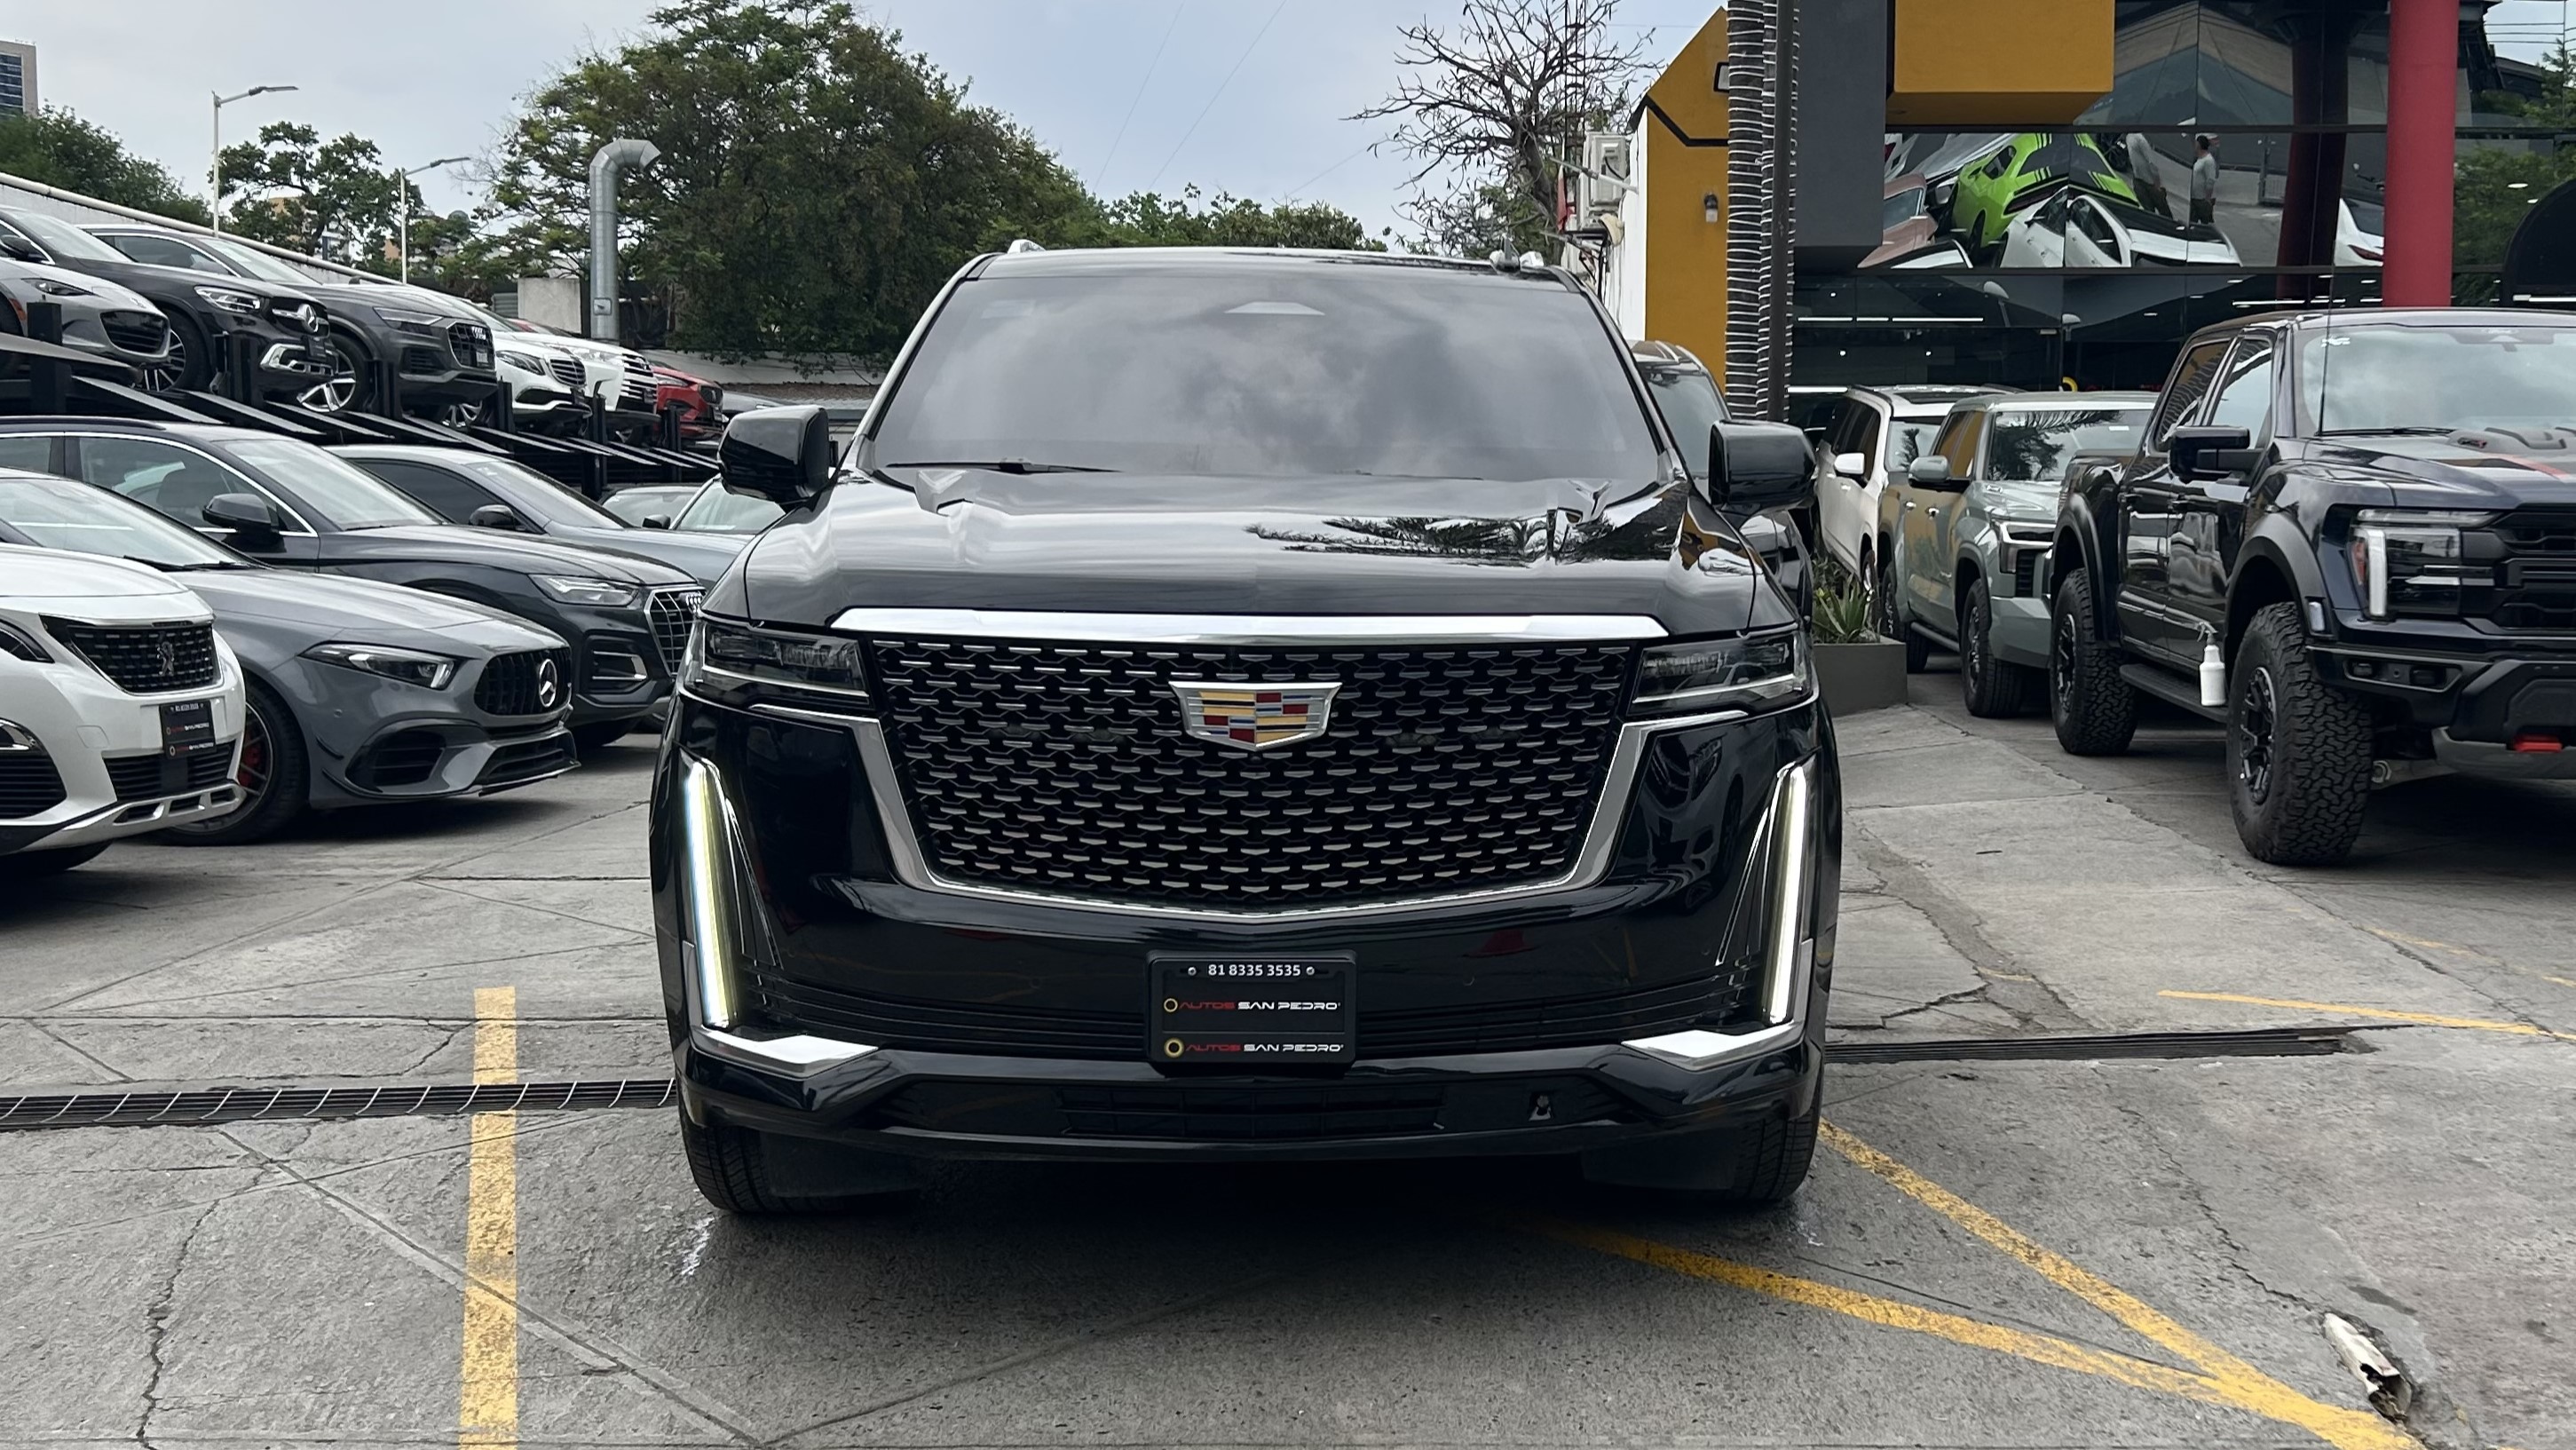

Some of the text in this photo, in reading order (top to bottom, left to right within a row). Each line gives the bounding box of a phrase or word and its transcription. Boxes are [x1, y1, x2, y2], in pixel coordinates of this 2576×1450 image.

[1208, 964, 1301, 976] 81 8335 3535
[1277, 1002, 1338, 1010] PEDRO
[1185, 1043, 1341, 1052] AUTOS SAN PEDRO
